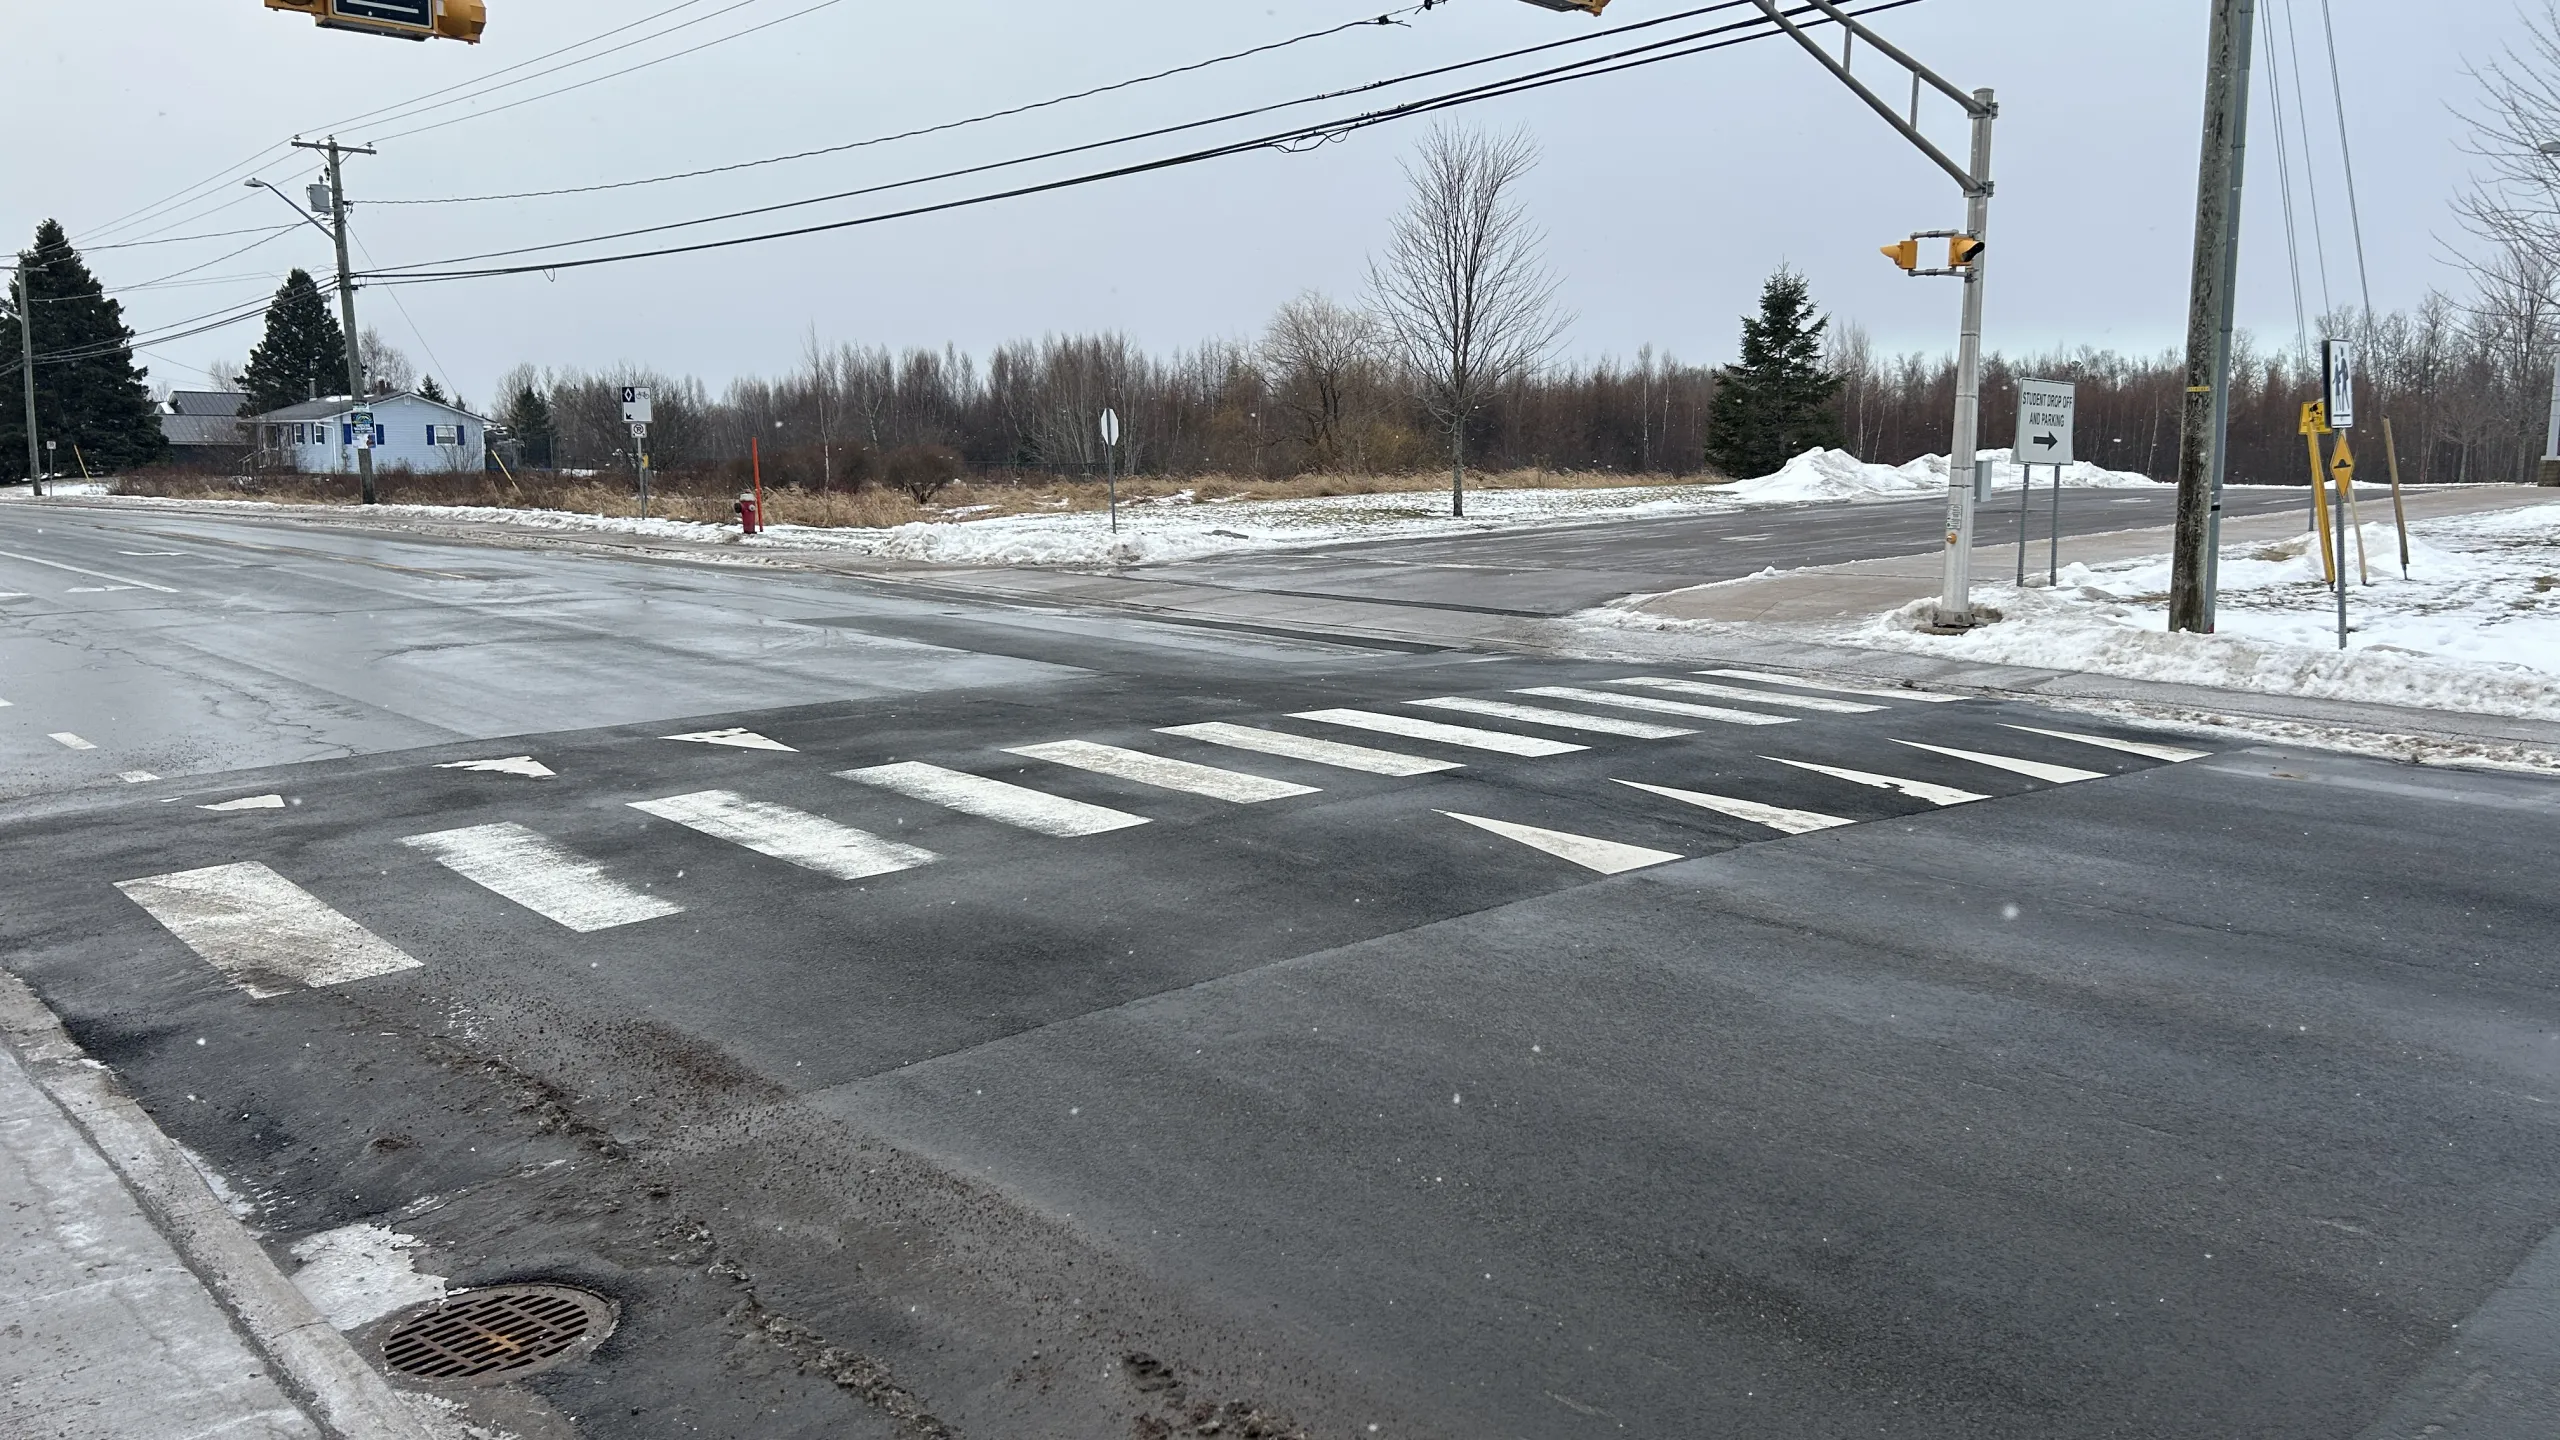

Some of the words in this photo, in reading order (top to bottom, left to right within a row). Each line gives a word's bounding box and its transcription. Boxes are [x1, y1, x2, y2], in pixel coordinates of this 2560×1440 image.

[2022, 391, 2047, 406] STUDENT
[2047, 394, 2062, 408] DROP
[2063, 396, 2073, 408] OFF
[2029, 412, 2041, 425] AND
[2041, 413, 2065, 427] PARKING
